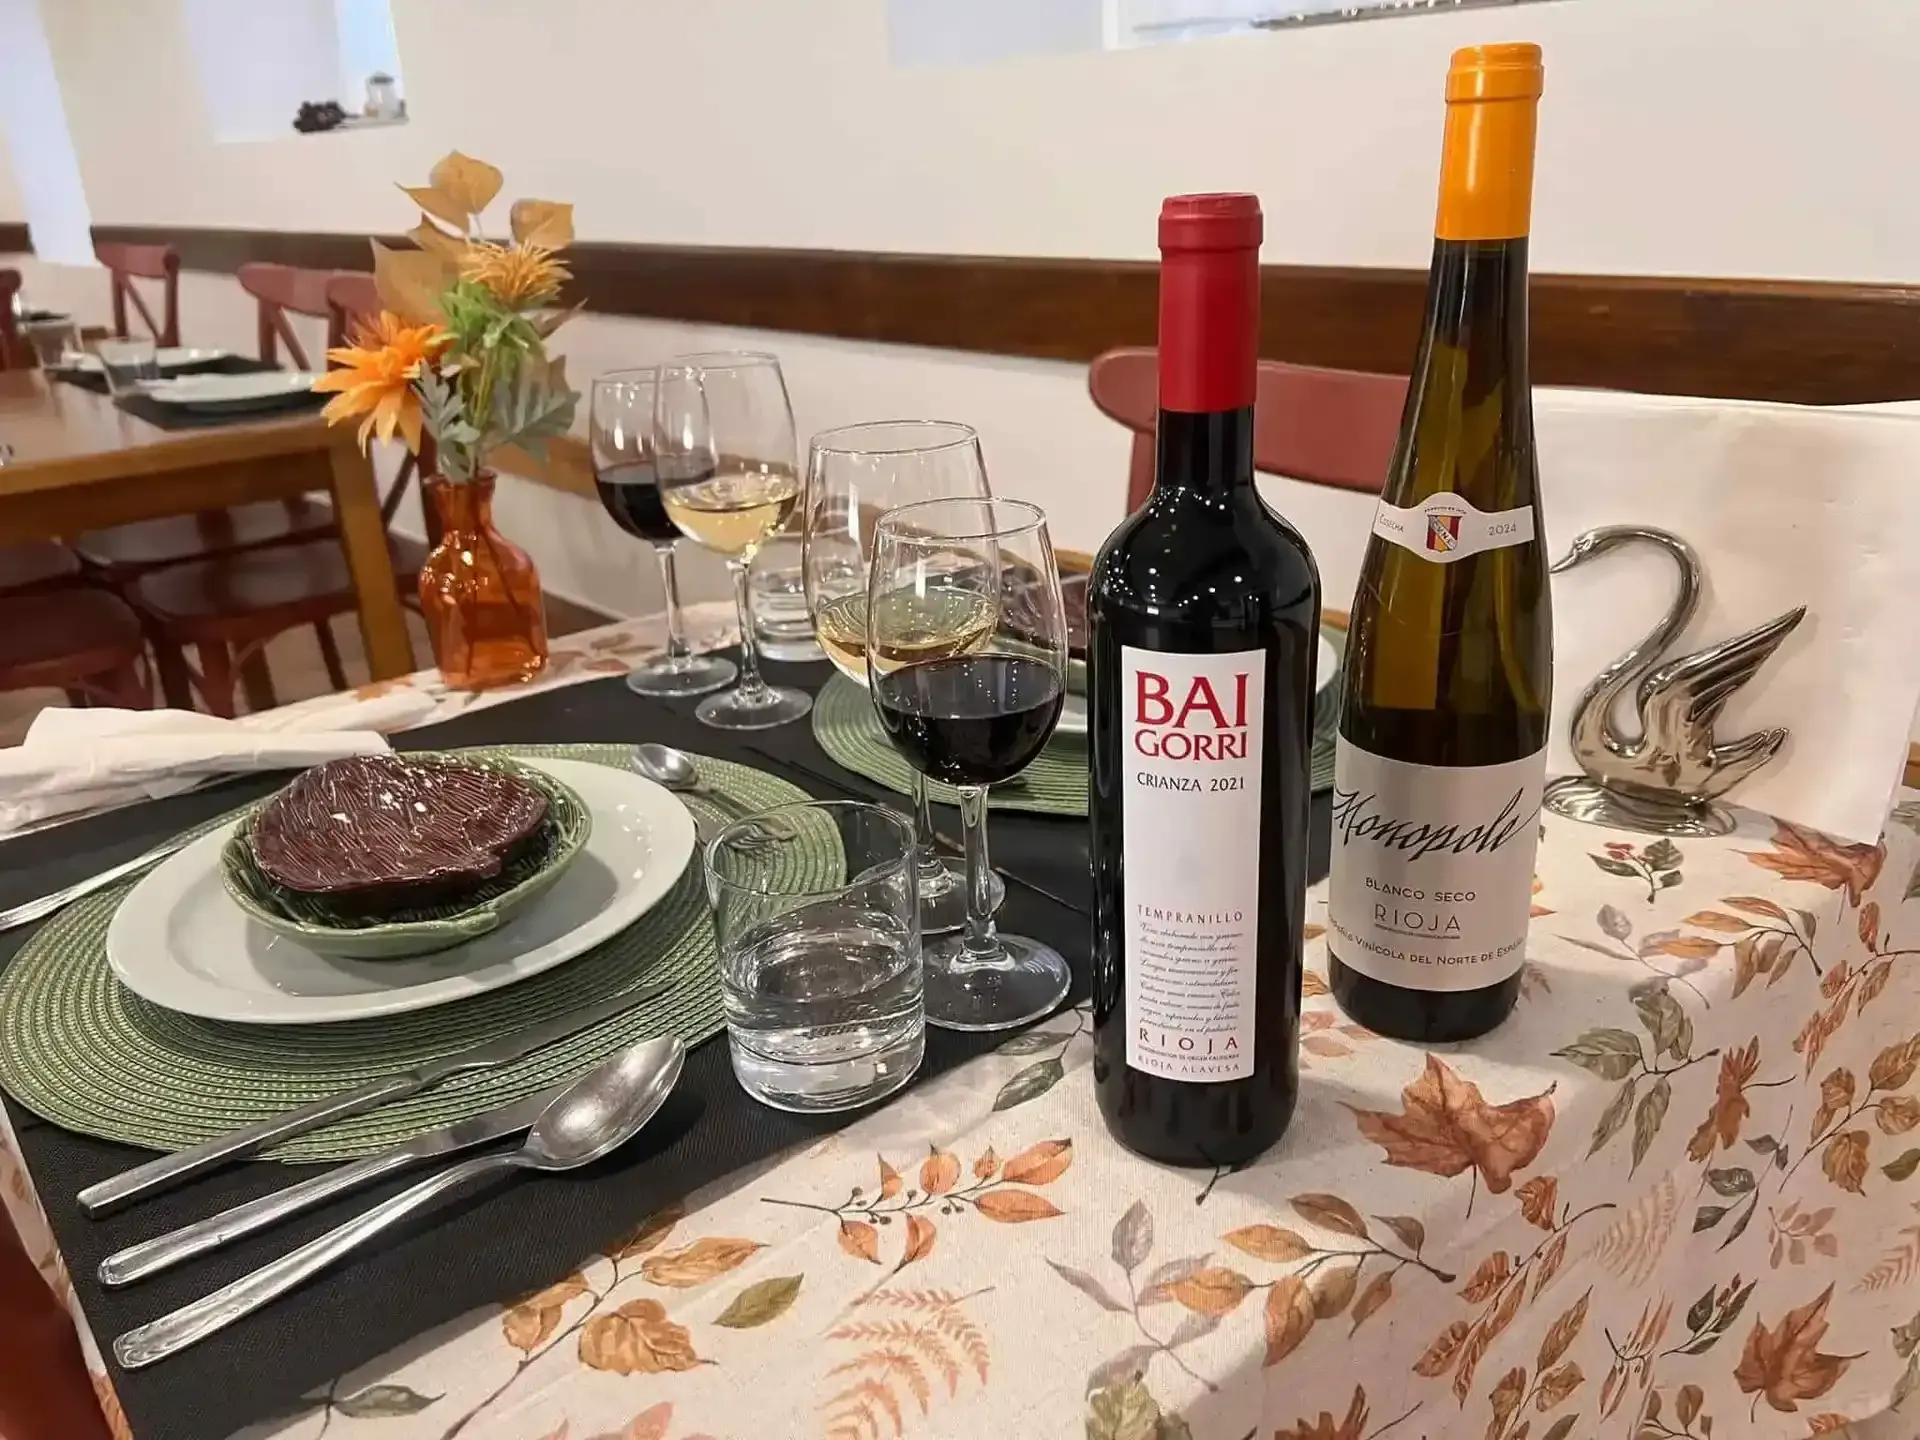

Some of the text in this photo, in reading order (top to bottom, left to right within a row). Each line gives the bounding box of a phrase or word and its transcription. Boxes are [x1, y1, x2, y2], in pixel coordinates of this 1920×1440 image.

[1488, 523, 1517, 536] 2024
[1135, 670, 1249, 729] BAI
[1135, 728, 1248, 761] GORRI
[1137, 772, 1244, 792] CRIANZA 2021
[1365, 876, 1476, 903] BLANCO SECO
[1138, 904, 1243, 924] TEMPRANILLO
[1374, 904, 1461, 932] RIOJA
[1410, 953, 1432, 965] DEL
[1436, 955, 1477, 966] NORTE
[1480, 952, 1494, 962] DE
[1139, 1027, 1238, 1054] RIOJA
[1138, 1055, 1241, 1073] RIOJA ALAVESA
